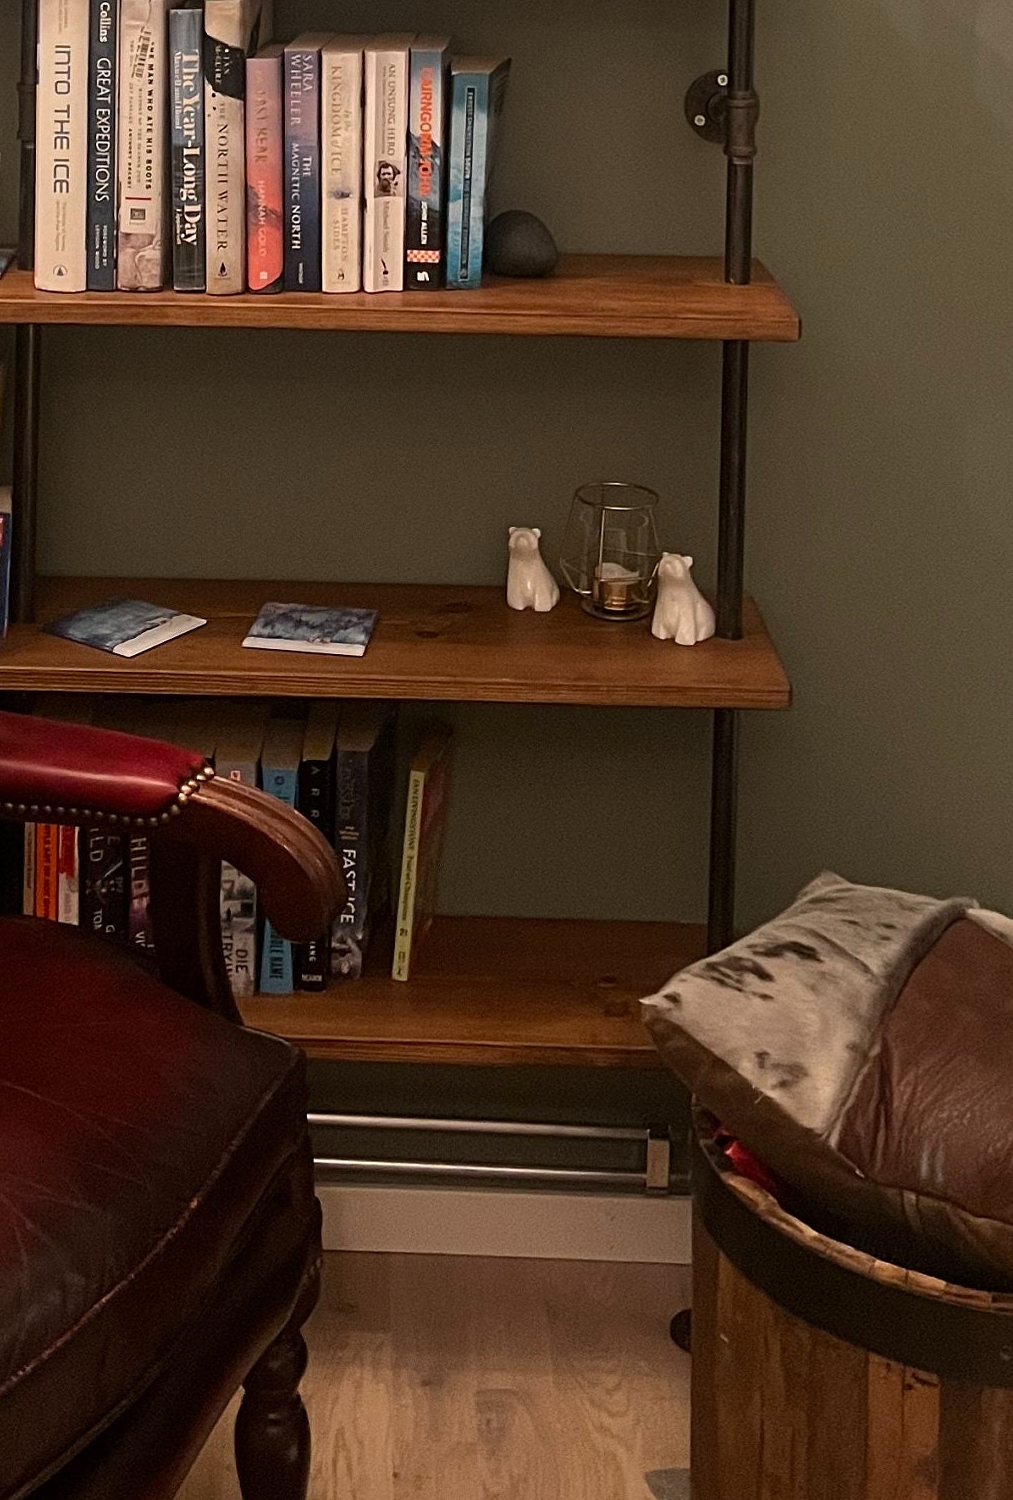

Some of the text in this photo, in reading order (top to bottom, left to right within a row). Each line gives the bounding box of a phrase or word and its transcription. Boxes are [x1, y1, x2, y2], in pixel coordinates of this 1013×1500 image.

[54, 45, 71, 95] INTO
[94, 1, 112, 202] Collins GREAT EXPEDITIONS
[290, 54, 303, 126] WHEELER
[302, 54, 313, 92] SARA
[54, 104, 71, 150] THE
[145, 63, 155, 191] MAN WHO ATE HIS BOOTS
[331, 65, 342, 177] KINGDOM ICE
[387, 63, 396, 157] AN UNSUNG HERO
[53, 158, 70, 194] ICE
[179, 49, 203, 247] The Year-Long Day
[302, 155, 312, 177] THE
[216, 124, 229, 251] NORTH WATER
[257, 180, 267, 257] HANNAH GOLD
[290, 143, 302, 250] MAGNETIC NORTH
[340, 206, 350, 261] HAMPTON
[340, 848, 357, 924] FAST ICE
[235, 949, 248, 974] DIE
[269, 957, 284, 980] NAME
